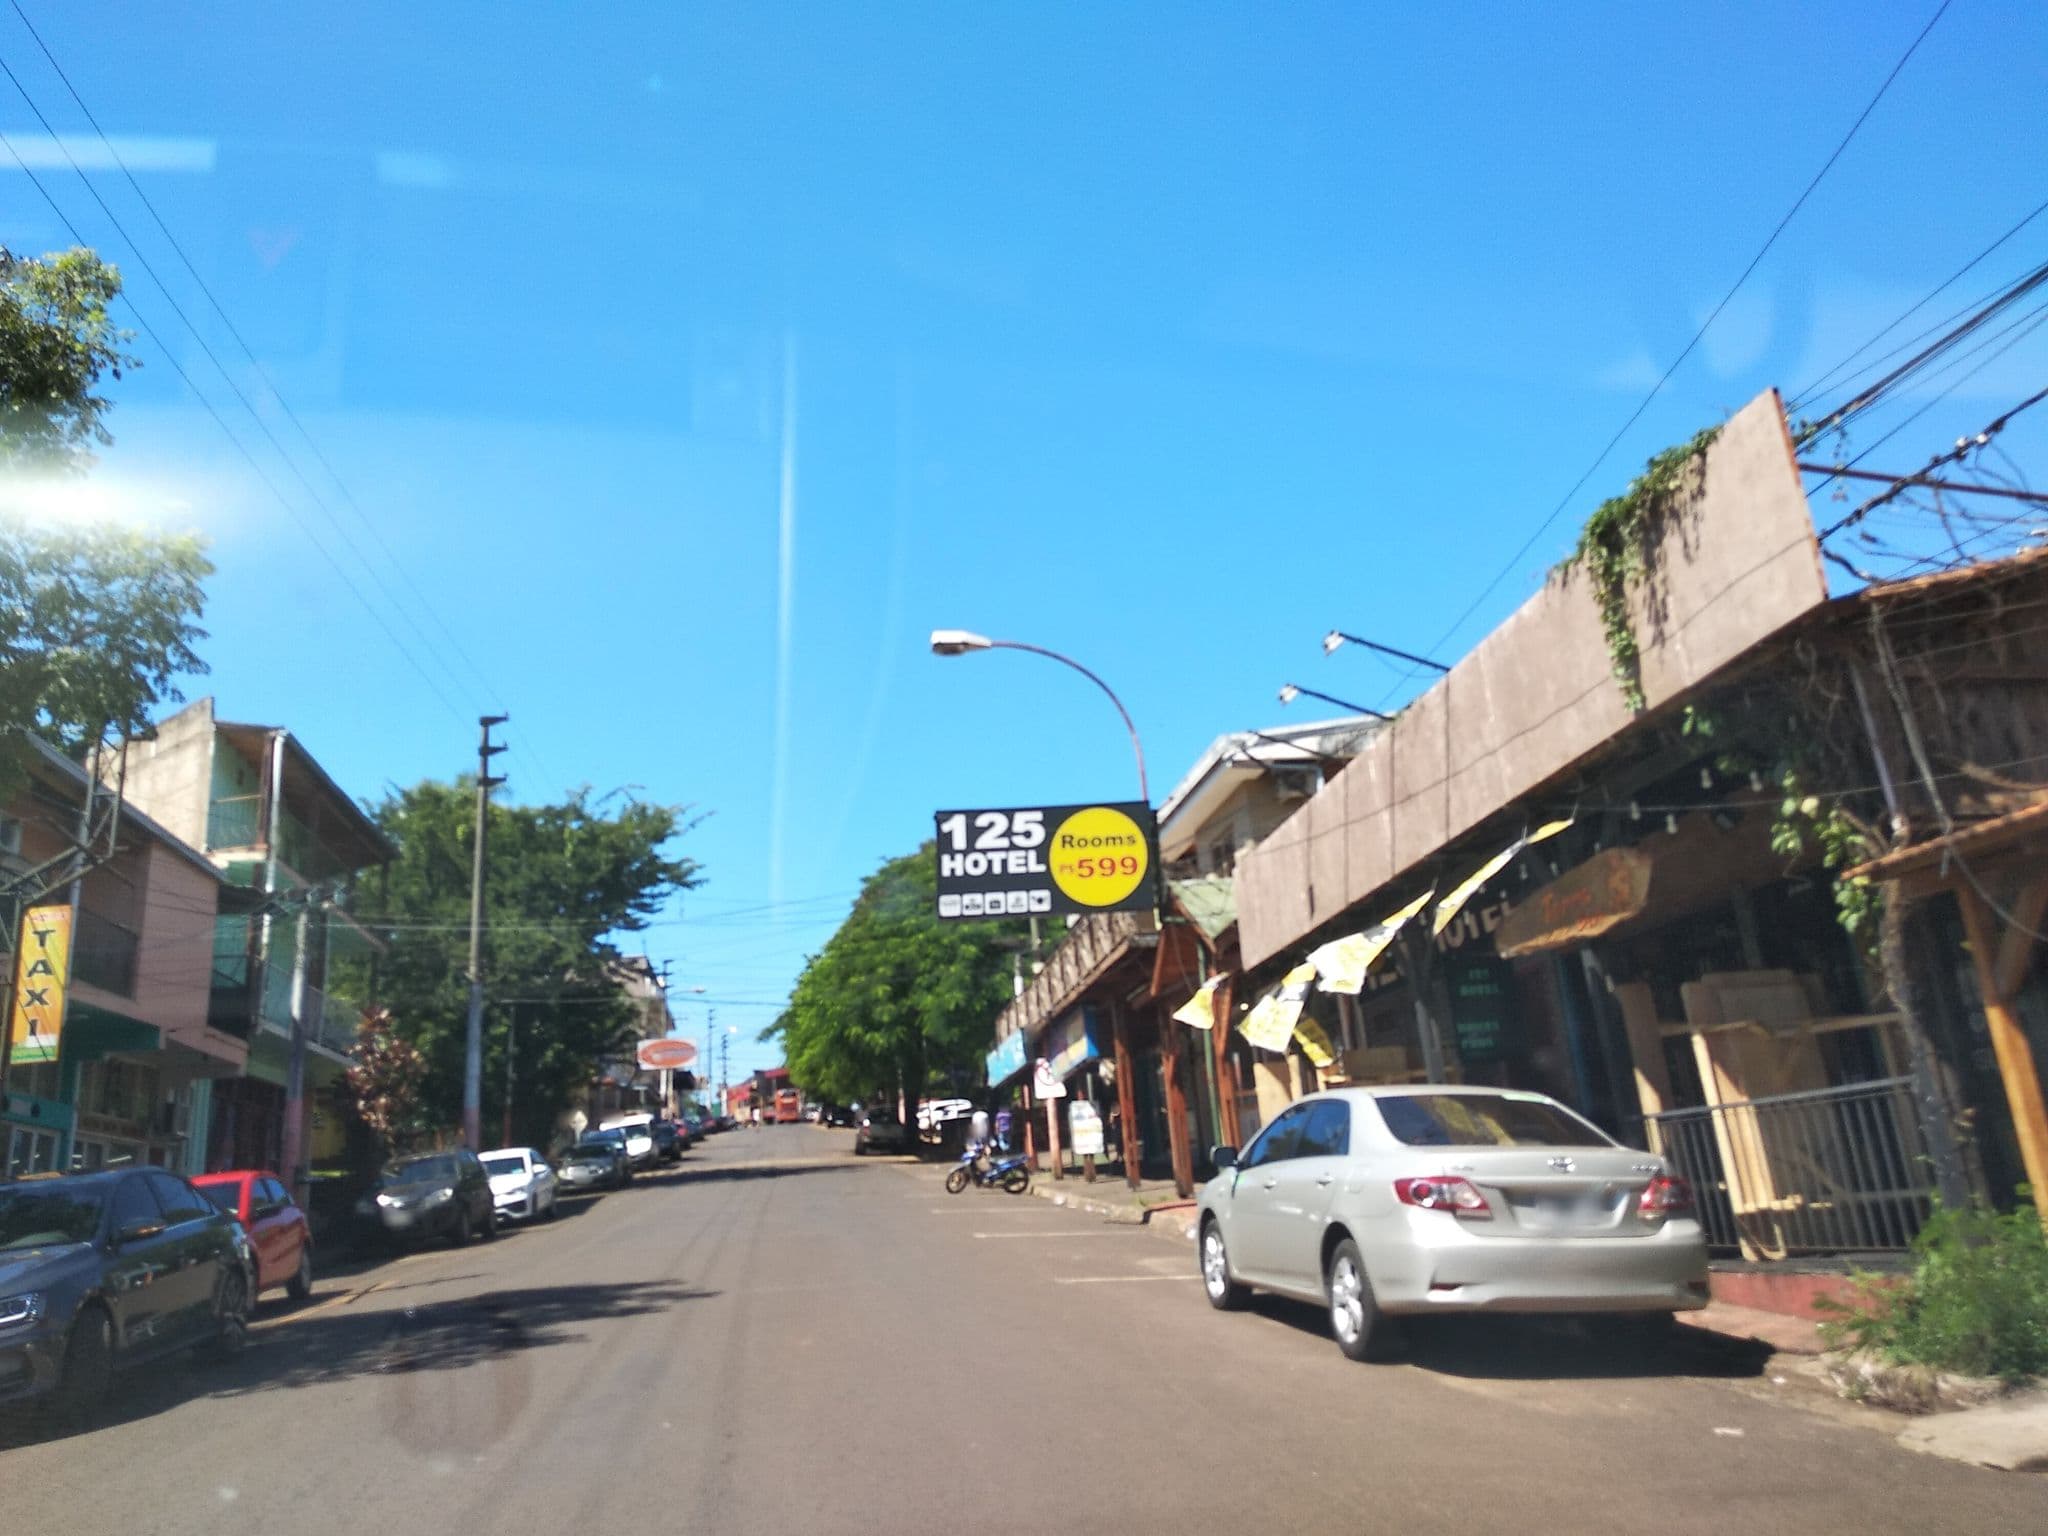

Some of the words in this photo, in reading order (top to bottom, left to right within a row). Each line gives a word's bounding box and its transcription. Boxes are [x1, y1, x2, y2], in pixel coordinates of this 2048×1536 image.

[941, 811, 1046, 850] 125
[1061, 834, 1137, 849] Rooms
[941, 850, 1047, 877] HOTEL
[1077, 856, 1138, 879] 599
[1434, 901, 1517, 953] OTEL
[25, 929, 56, 1037] TAXI
